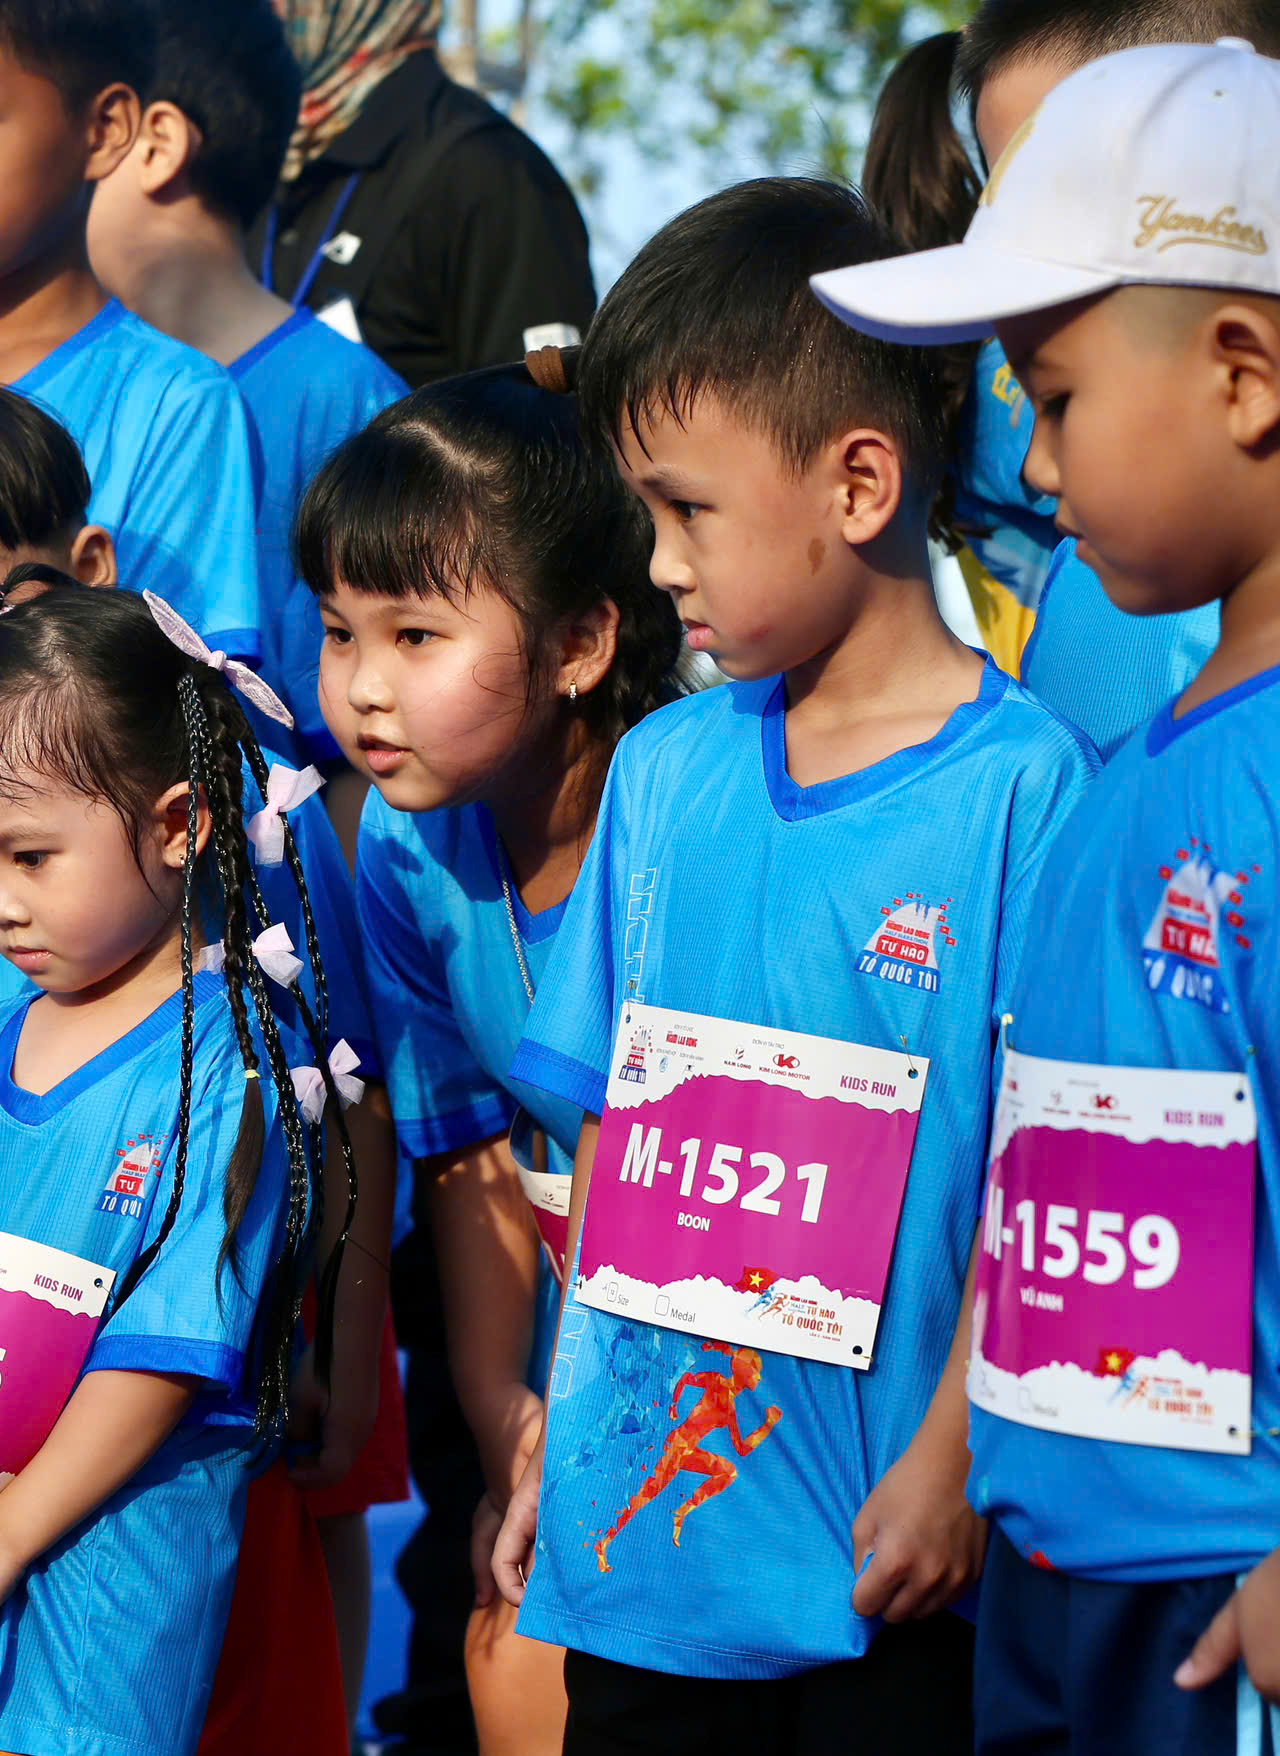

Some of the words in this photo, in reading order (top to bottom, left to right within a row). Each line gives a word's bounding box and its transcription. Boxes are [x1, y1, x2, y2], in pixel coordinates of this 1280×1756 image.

[1134, 195, 1268, 253] Yankees
[880, 960, 913, 985] QUỐC
[918, 969, 937, 992] TÔI
[737, 1061, 752, 1070] LONG
[771, 1068, 787, 1077] LONG
[788, 1071, 811, 1081] MOTOR
[839, 1075, 868, 1093] KIDS
[871, 1081, 897, 1098] RUN
[1197, 1111, 1225, 1128] RUN
[618, 1122, 829, 1224] M-1521
[677, 1212, 711, 1231] BOON
[983, 1182, 1180, 1291] M-1559
[33, 1273, 59, 1293] KIDS
[60, 1283, 84, 1302] RUN
[617, 1294, 630, 1307] Size
[670, 1308, 697, 1323] Medal
[1036, 1291, 1064, 1312] ANH
[796, 1315, 823, 1332] QUỐC
[827, 1321, 843, 1336] TÔI
